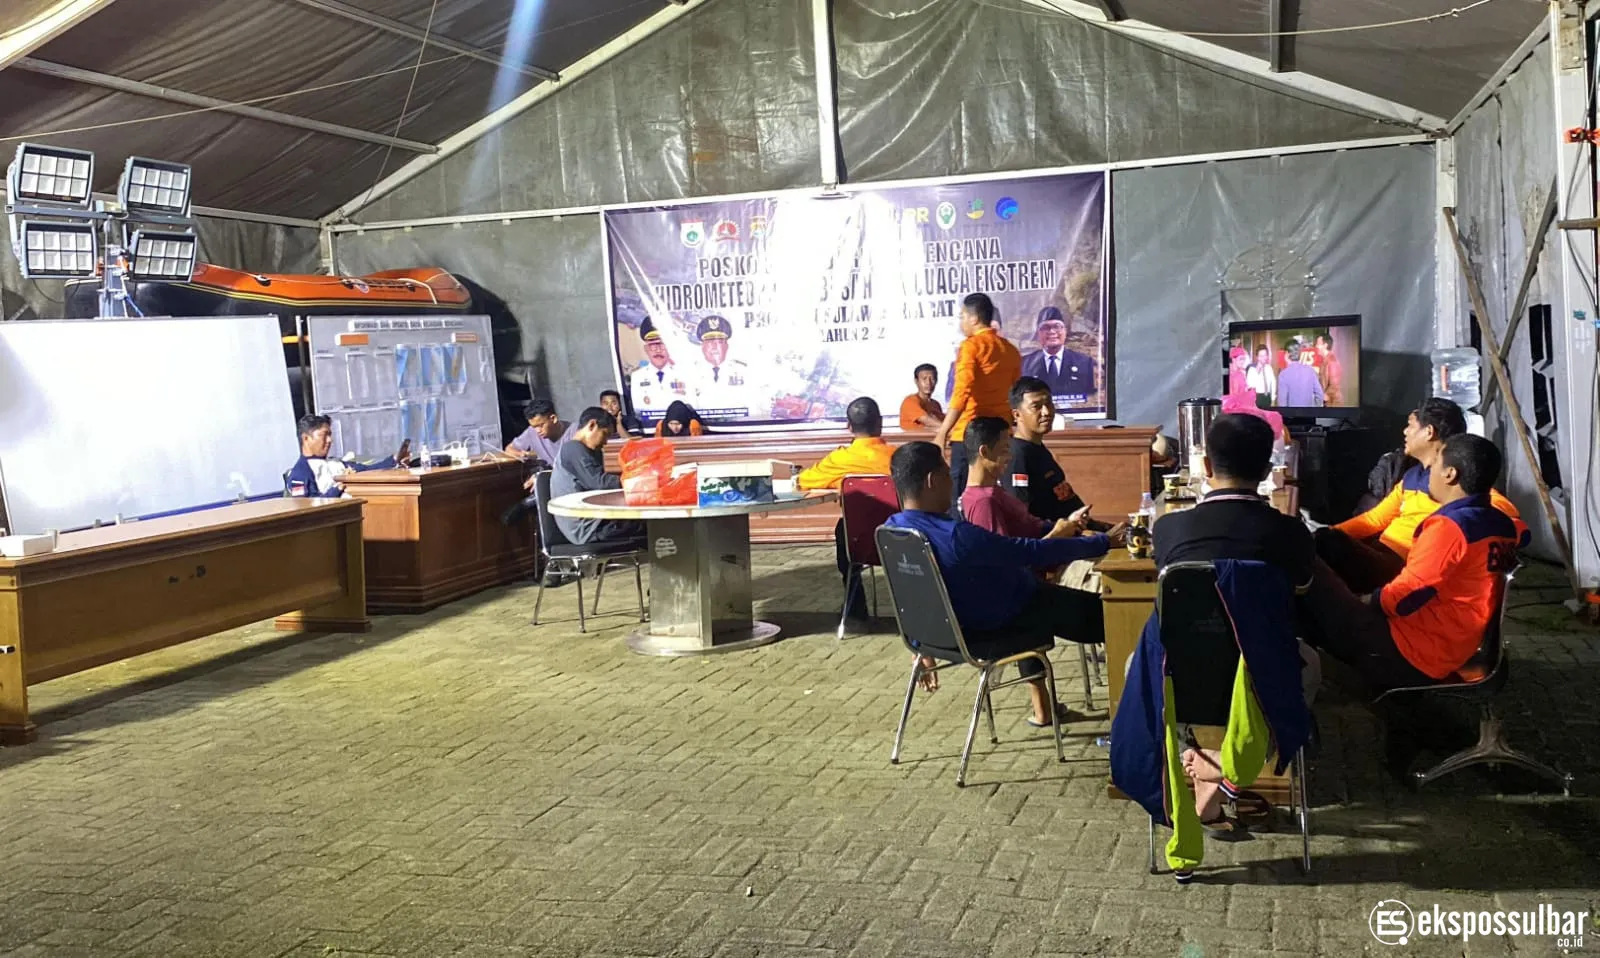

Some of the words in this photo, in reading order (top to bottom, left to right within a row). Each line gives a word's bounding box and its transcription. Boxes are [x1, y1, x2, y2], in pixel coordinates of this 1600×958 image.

[699, 255, 757, 279] POSKO
[925, 237, 1001, 263] ENCANA
[975, 259, 1055, 292] EKSTREM
